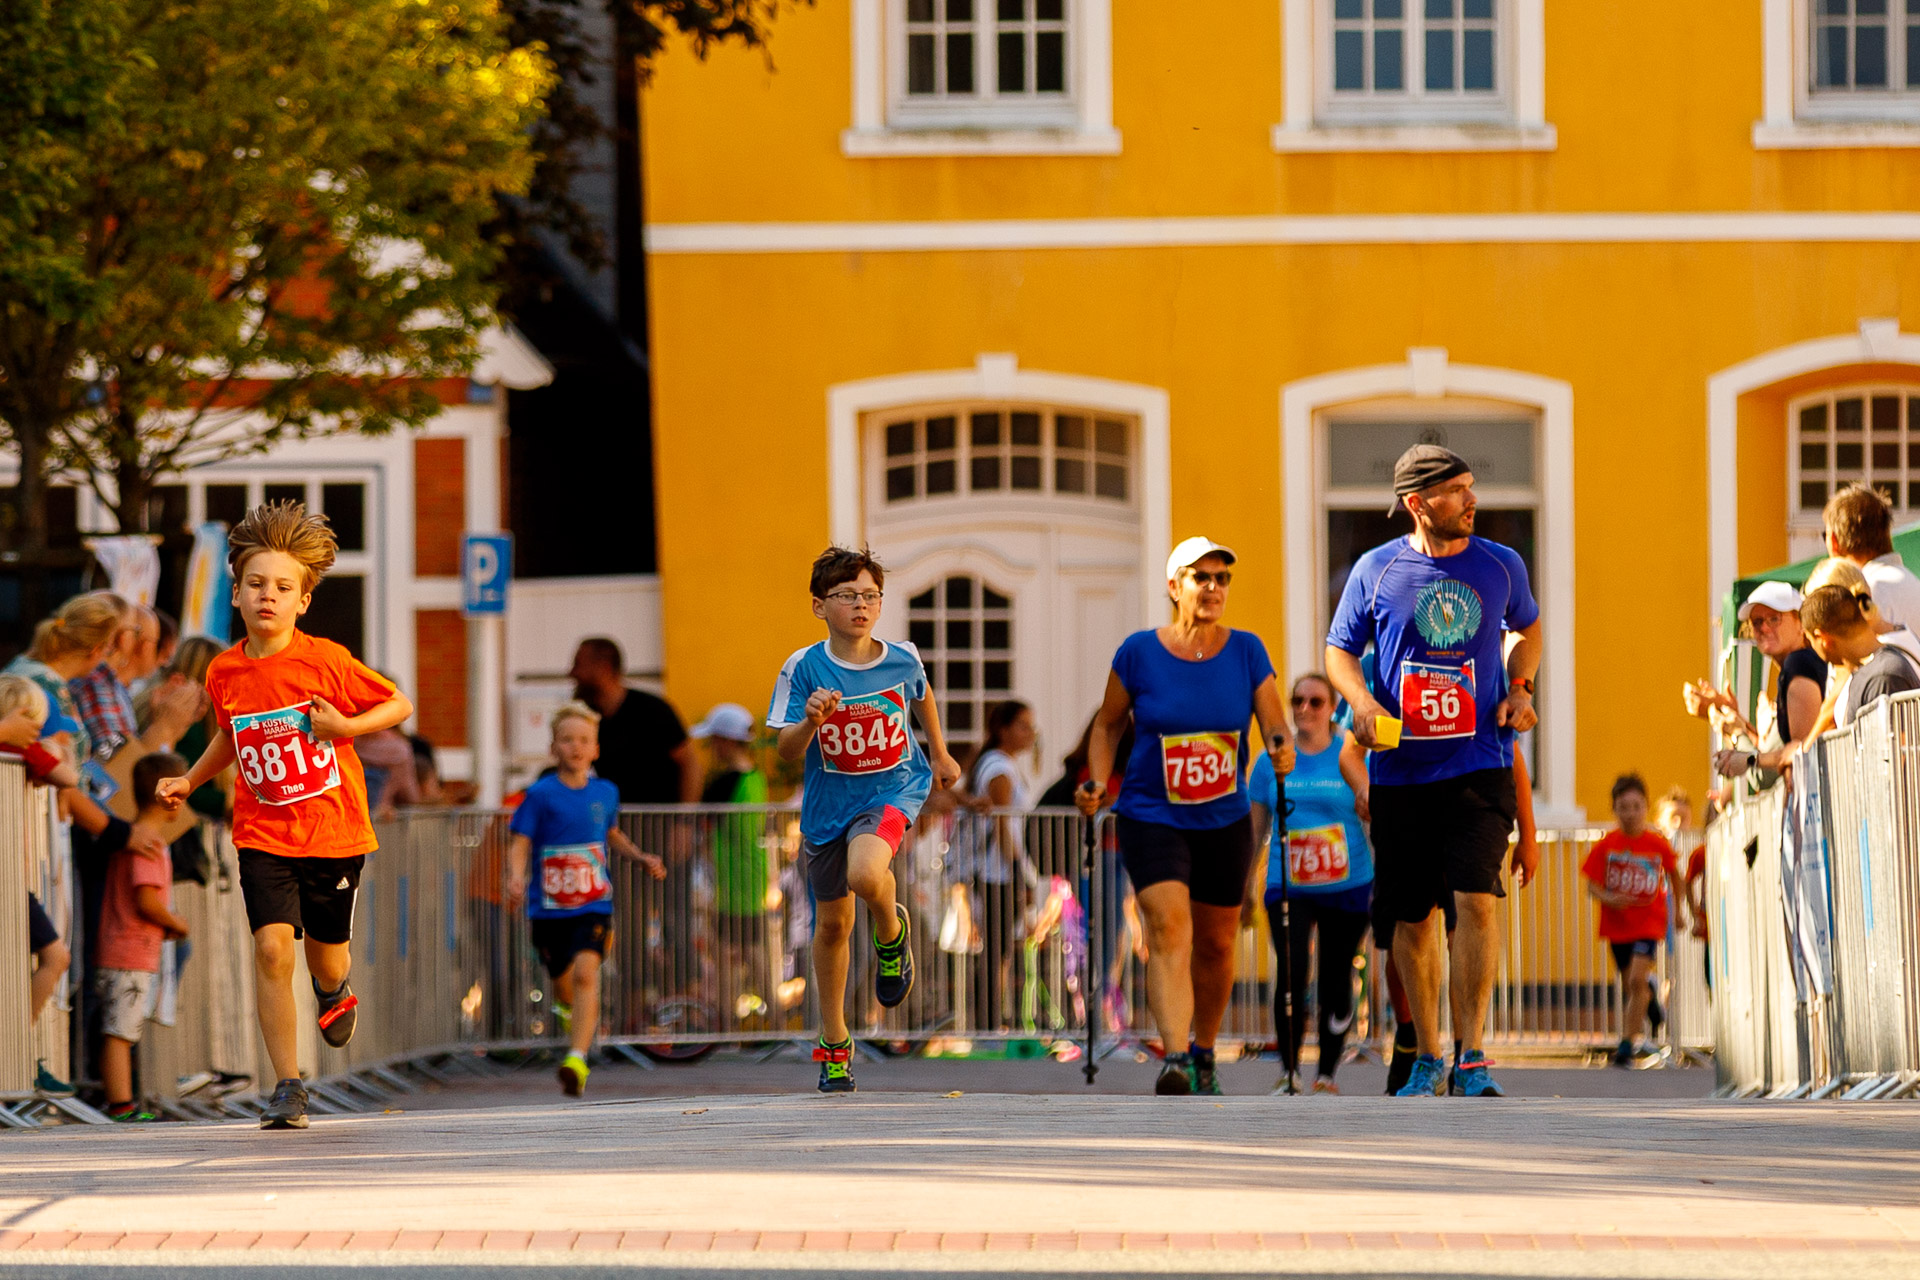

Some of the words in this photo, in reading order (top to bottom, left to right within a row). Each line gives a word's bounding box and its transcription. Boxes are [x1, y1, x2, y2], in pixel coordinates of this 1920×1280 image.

[468, 541, 499, 606] P
[849, 700, 879, 710] KÜSTEN
[850, 704, 888, 717] MARATHON
[1421, 688, 1460, 721] 56
[262, 715, 295, 729] KÜSTEN
[264, 720, 304, 736] MARATHON
[1429, 722, 1456, 732] Marcel
[821, 711, 905, 756] 3842
[857, 757, 881, 768] Jakob
[1168, 749, 1236, 788] 7534
[281, 783, 304, 795] Theo
